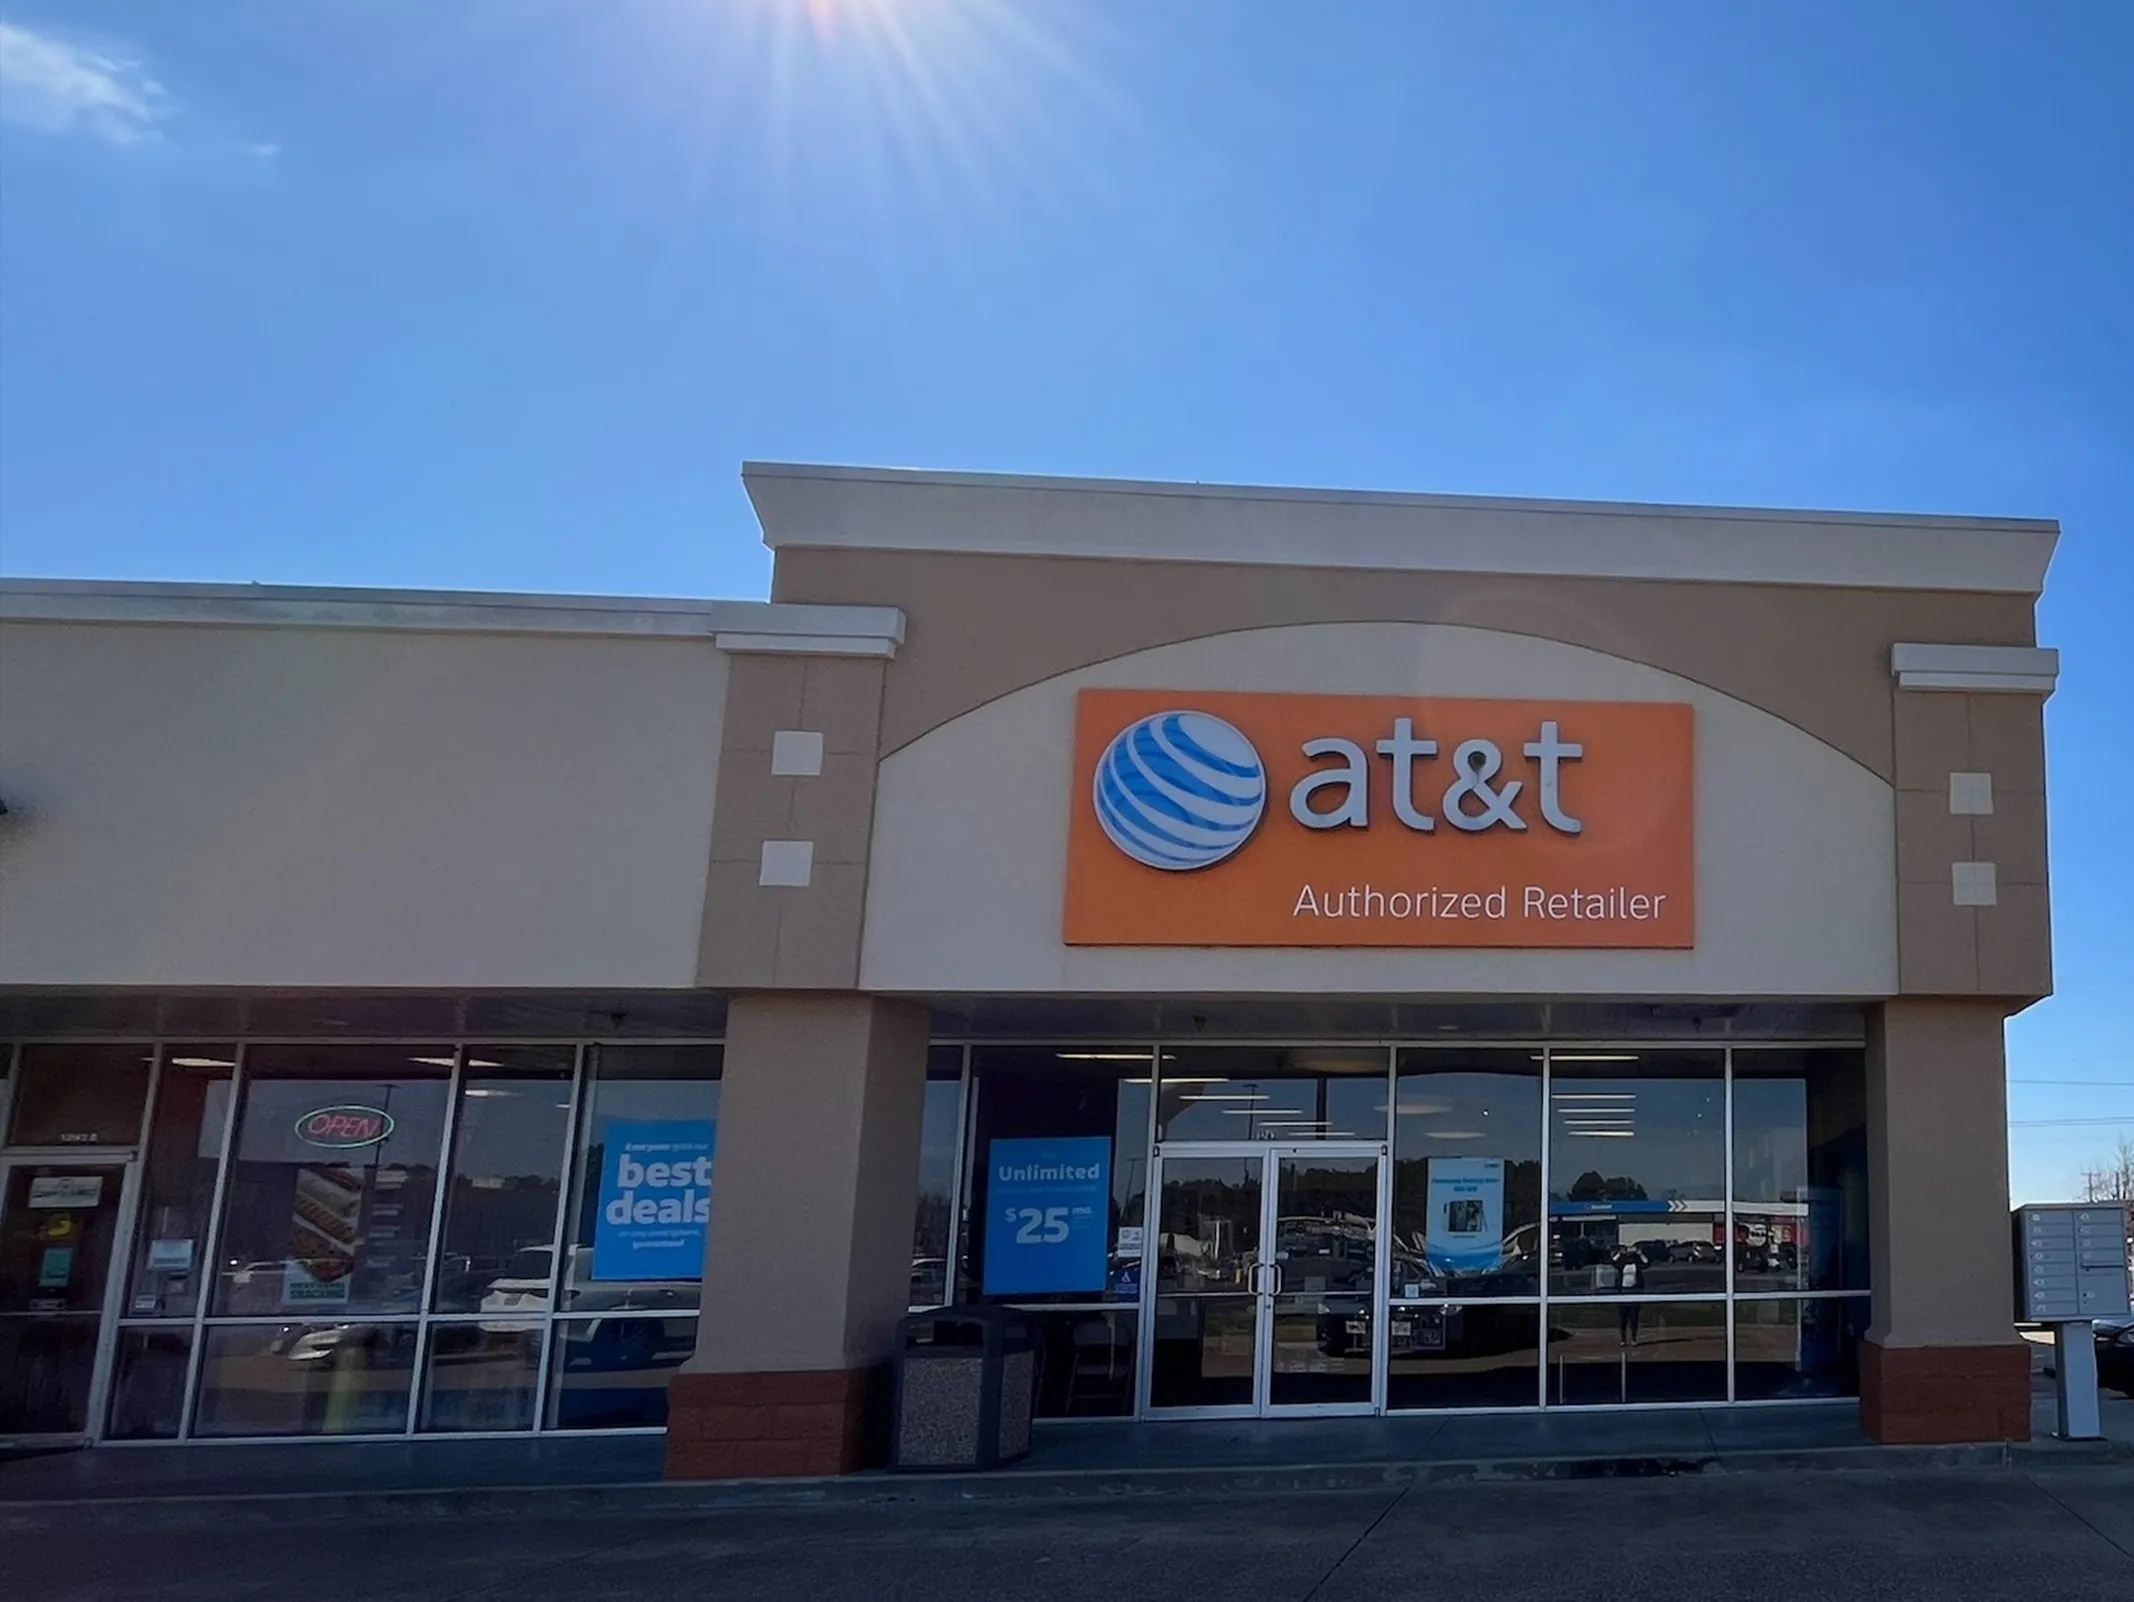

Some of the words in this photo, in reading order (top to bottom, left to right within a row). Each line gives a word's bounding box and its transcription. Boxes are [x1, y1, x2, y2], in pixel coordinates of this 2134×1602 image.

[1289, 717, 1583, 834] at&t
[1293, 883, 1507, 919] Authorized
[1523, 885, 1667, 920] Retailer
[307, 1113, 382, 1139] OPEN
[617, 1153, 712, 1188] best
[999, 1163, 1099, 1181] Unlimited
[606, 1189, 710, 1225] deals
